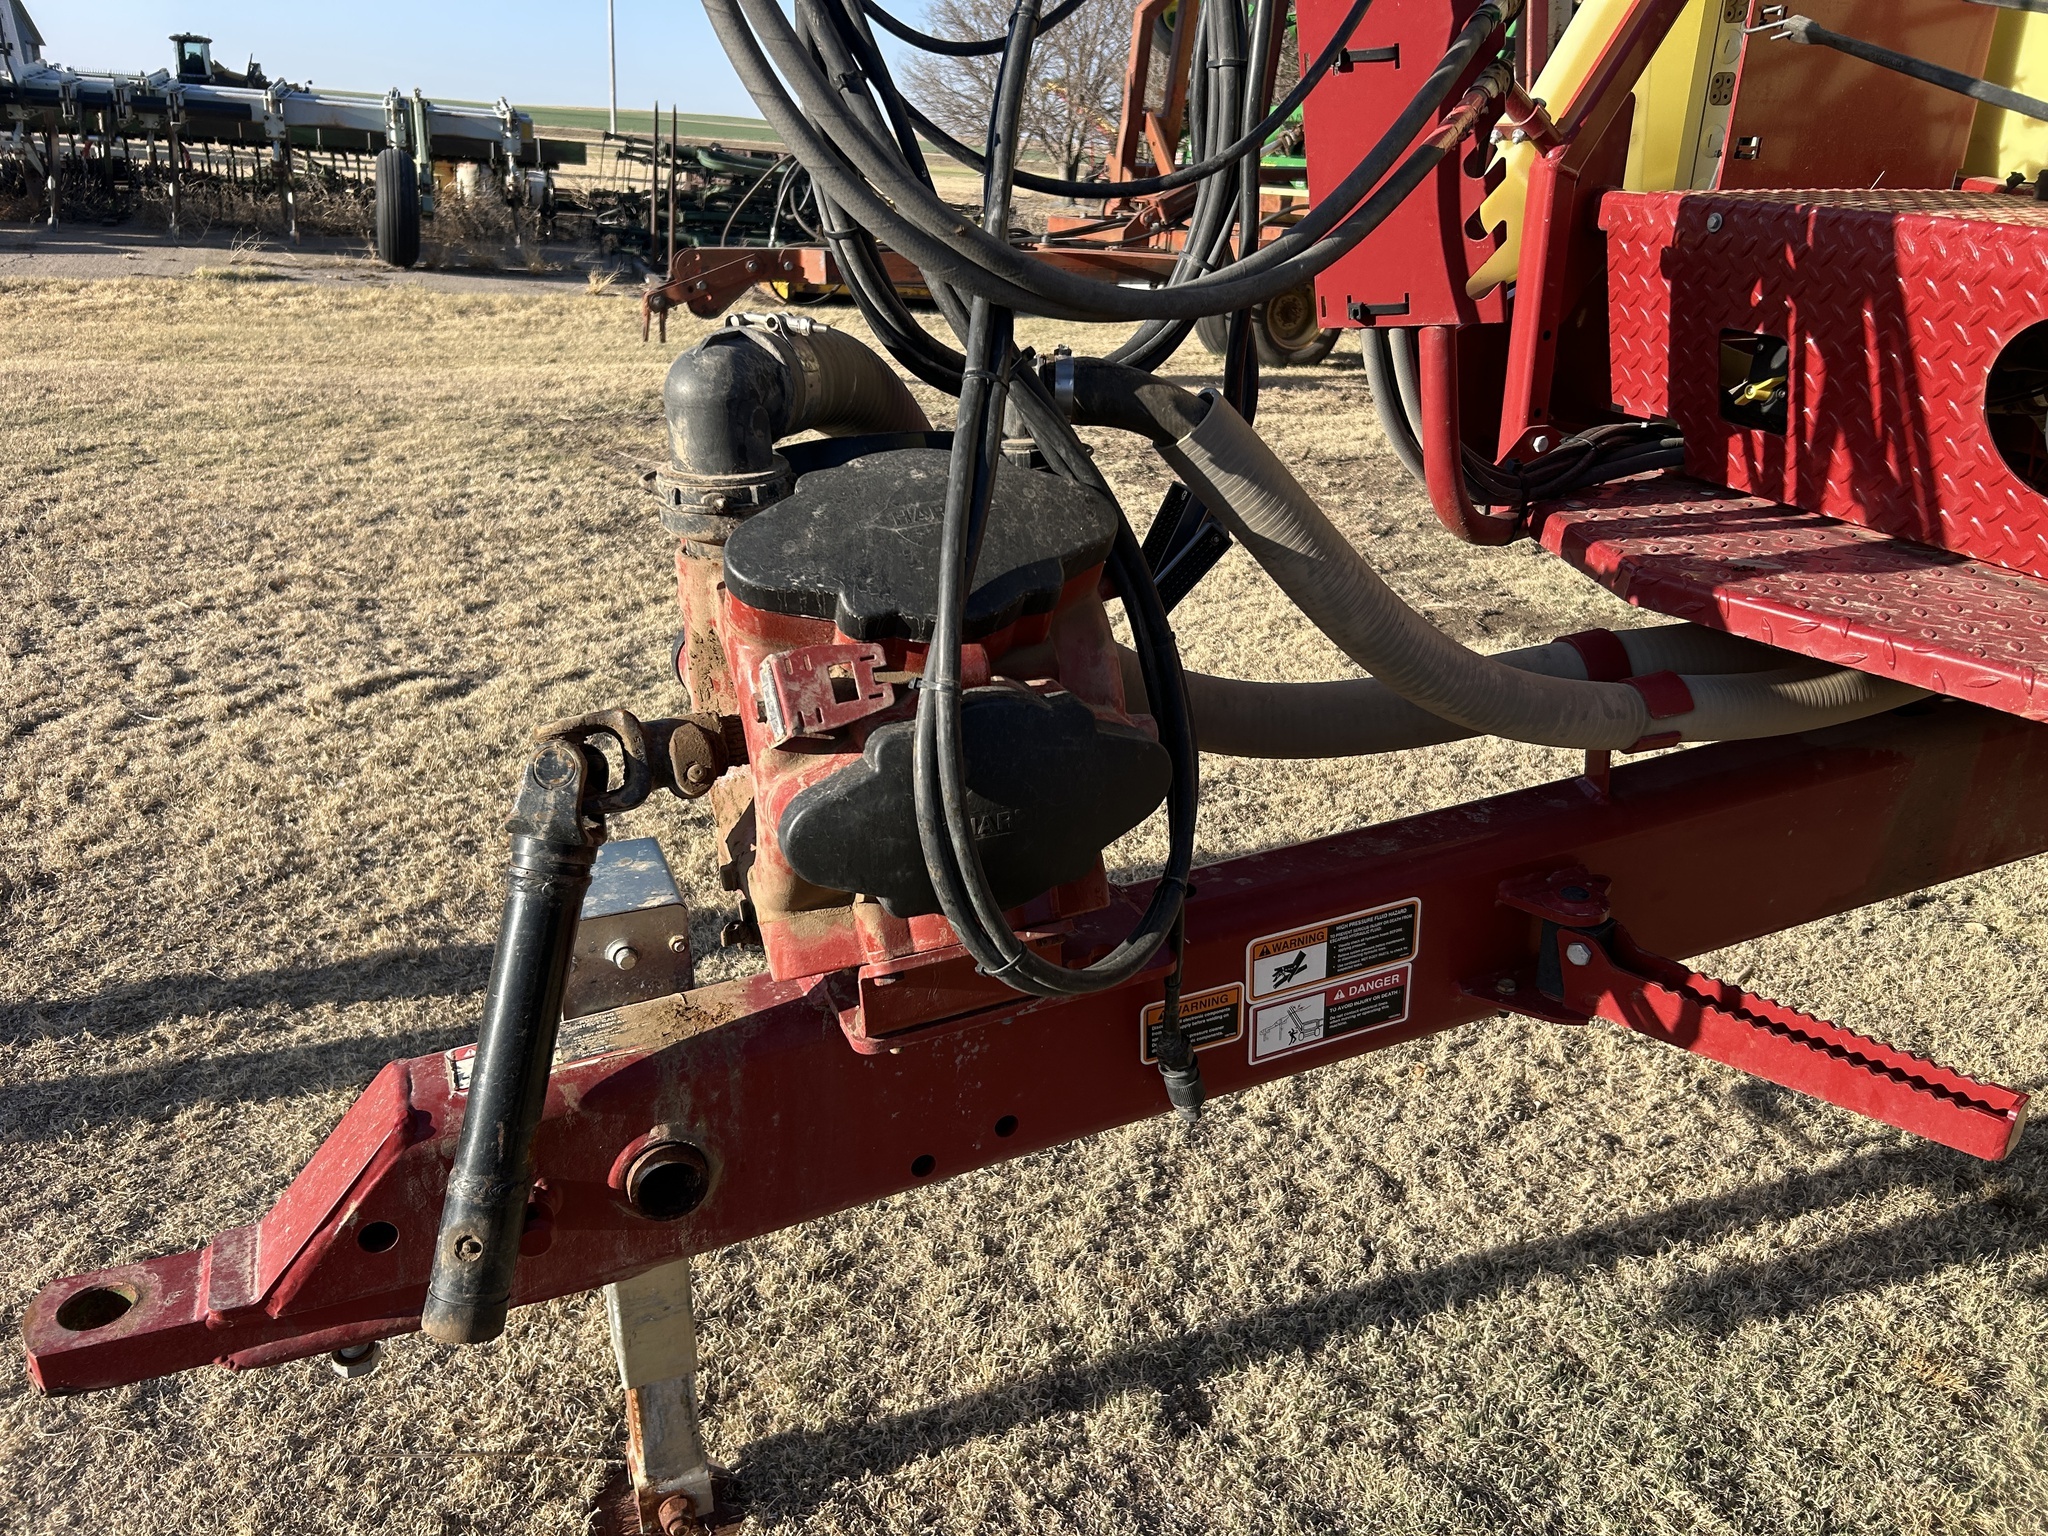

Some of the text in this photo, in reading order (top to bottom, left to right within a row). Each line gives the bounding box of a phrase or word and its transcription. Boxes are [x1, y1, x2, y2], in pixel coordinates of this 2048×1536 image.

[1349, 917, 1373, 928] PRESSURE
[1374, 912, 1388, 920] FLUID
[1388, 908, 1407, 917] HAZARD
[1330, 936, 1349, 944] ESCAPING
[1349, 930, 1370, 938] HYDRAULIC
[1335, 929, 1352, 937] PREVENT
[1353, 925, 1369, 933] SERIOUS
[1389, 927, 1403, 935] BEFORE
[1272, 931, 1324, 952] WARNING
[1349, 974, 1400, 996] DANGER
[1180, 994, 1228, 1015] ARNING
[1337, 1003, 1353, 1011] AVOID
[1354, 998, 1372, 1006] INJURY
[1381, 990, 1398, 998] DEATH
[1360, 1003, 1377, 1011] electrical
[1182, 1014, 1204, 1023] electronic
[1204, 1007, 1230, 1017] components
[1206, 1014, 1223, 1022] welding
[1361, 1007, 1380, 1016] operating
[1190, 1030, 1208, 1038] pressure
